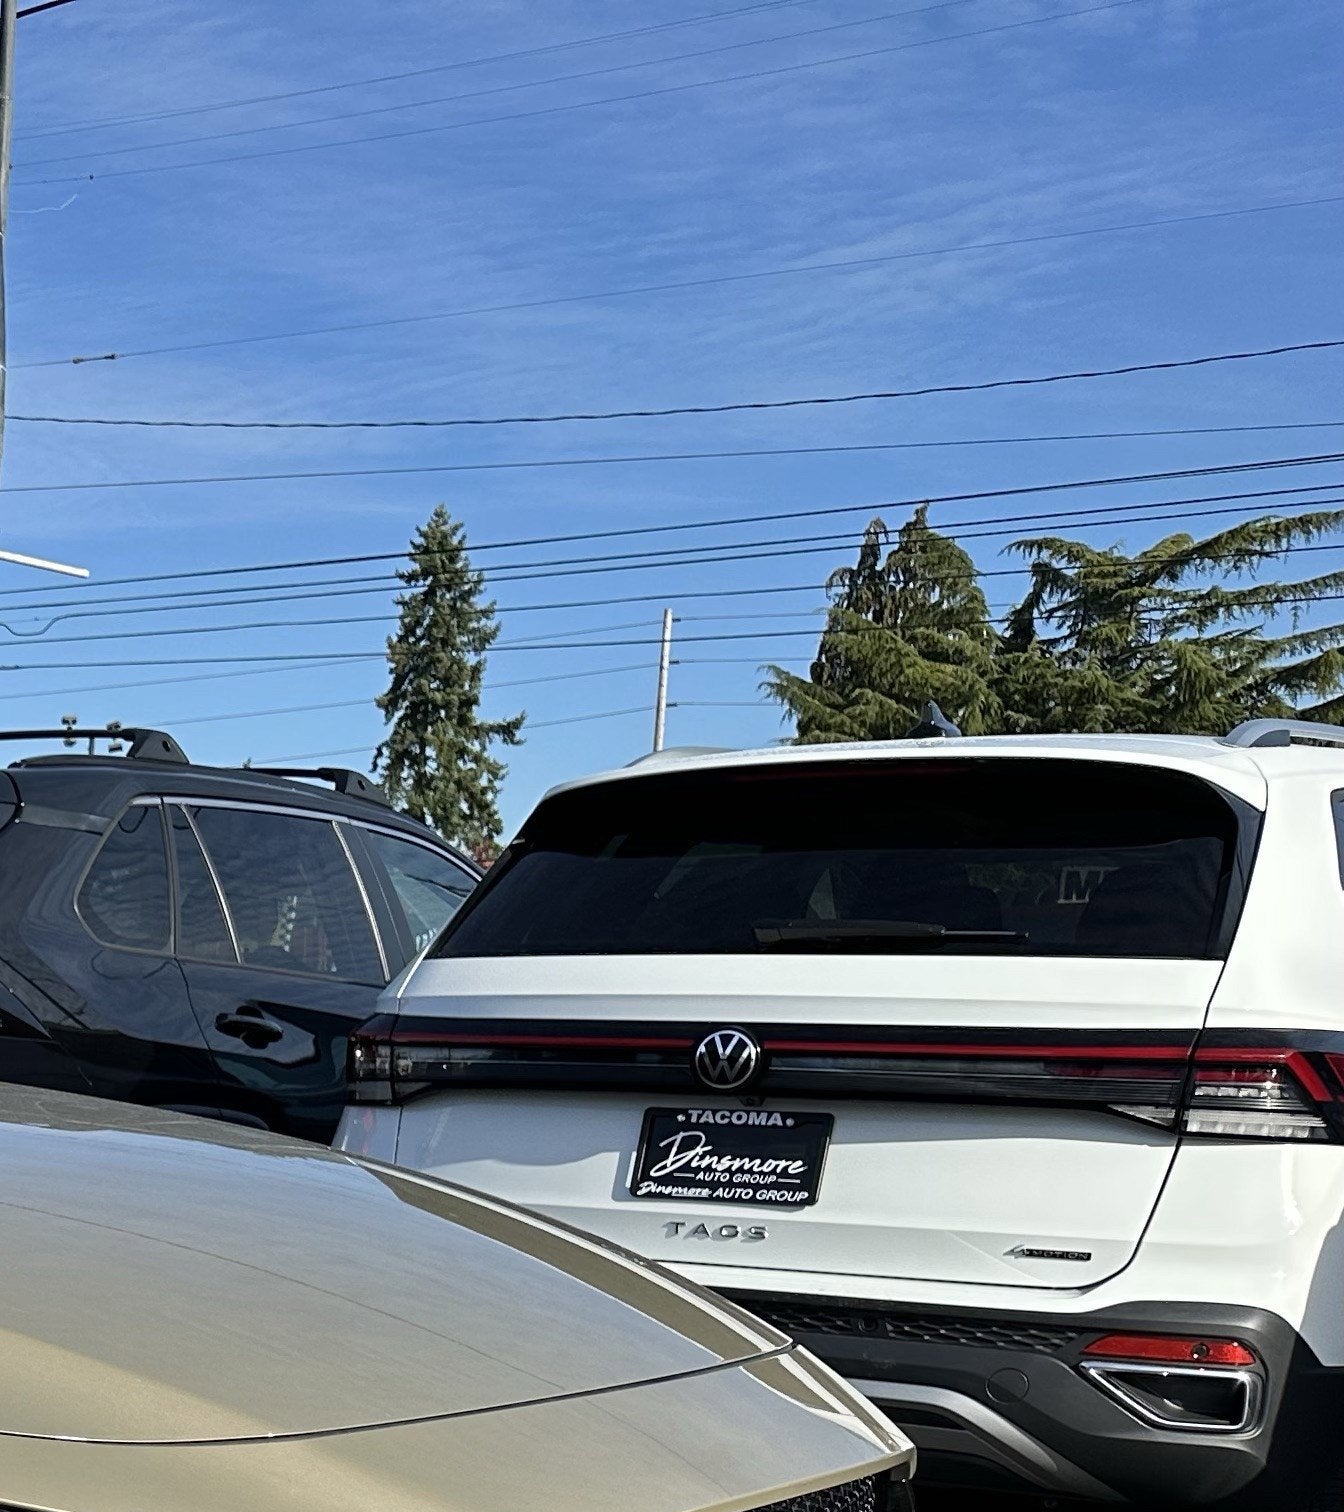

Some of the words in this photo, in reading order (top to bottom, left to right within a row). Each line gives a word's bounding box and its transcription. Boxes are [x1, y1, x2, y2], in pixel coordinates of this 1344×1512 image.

[688, 1109, 783, 1127] TACOMA
[650, 1131, 808, 1177] Dinsmore
[695, 1171, 730, 1182] AUTO
[732, 1172, 777, 1185] GROUP
[712, 1187, 753, 1199] AUTO
[755, 1189, 809, 1202] GROUP
